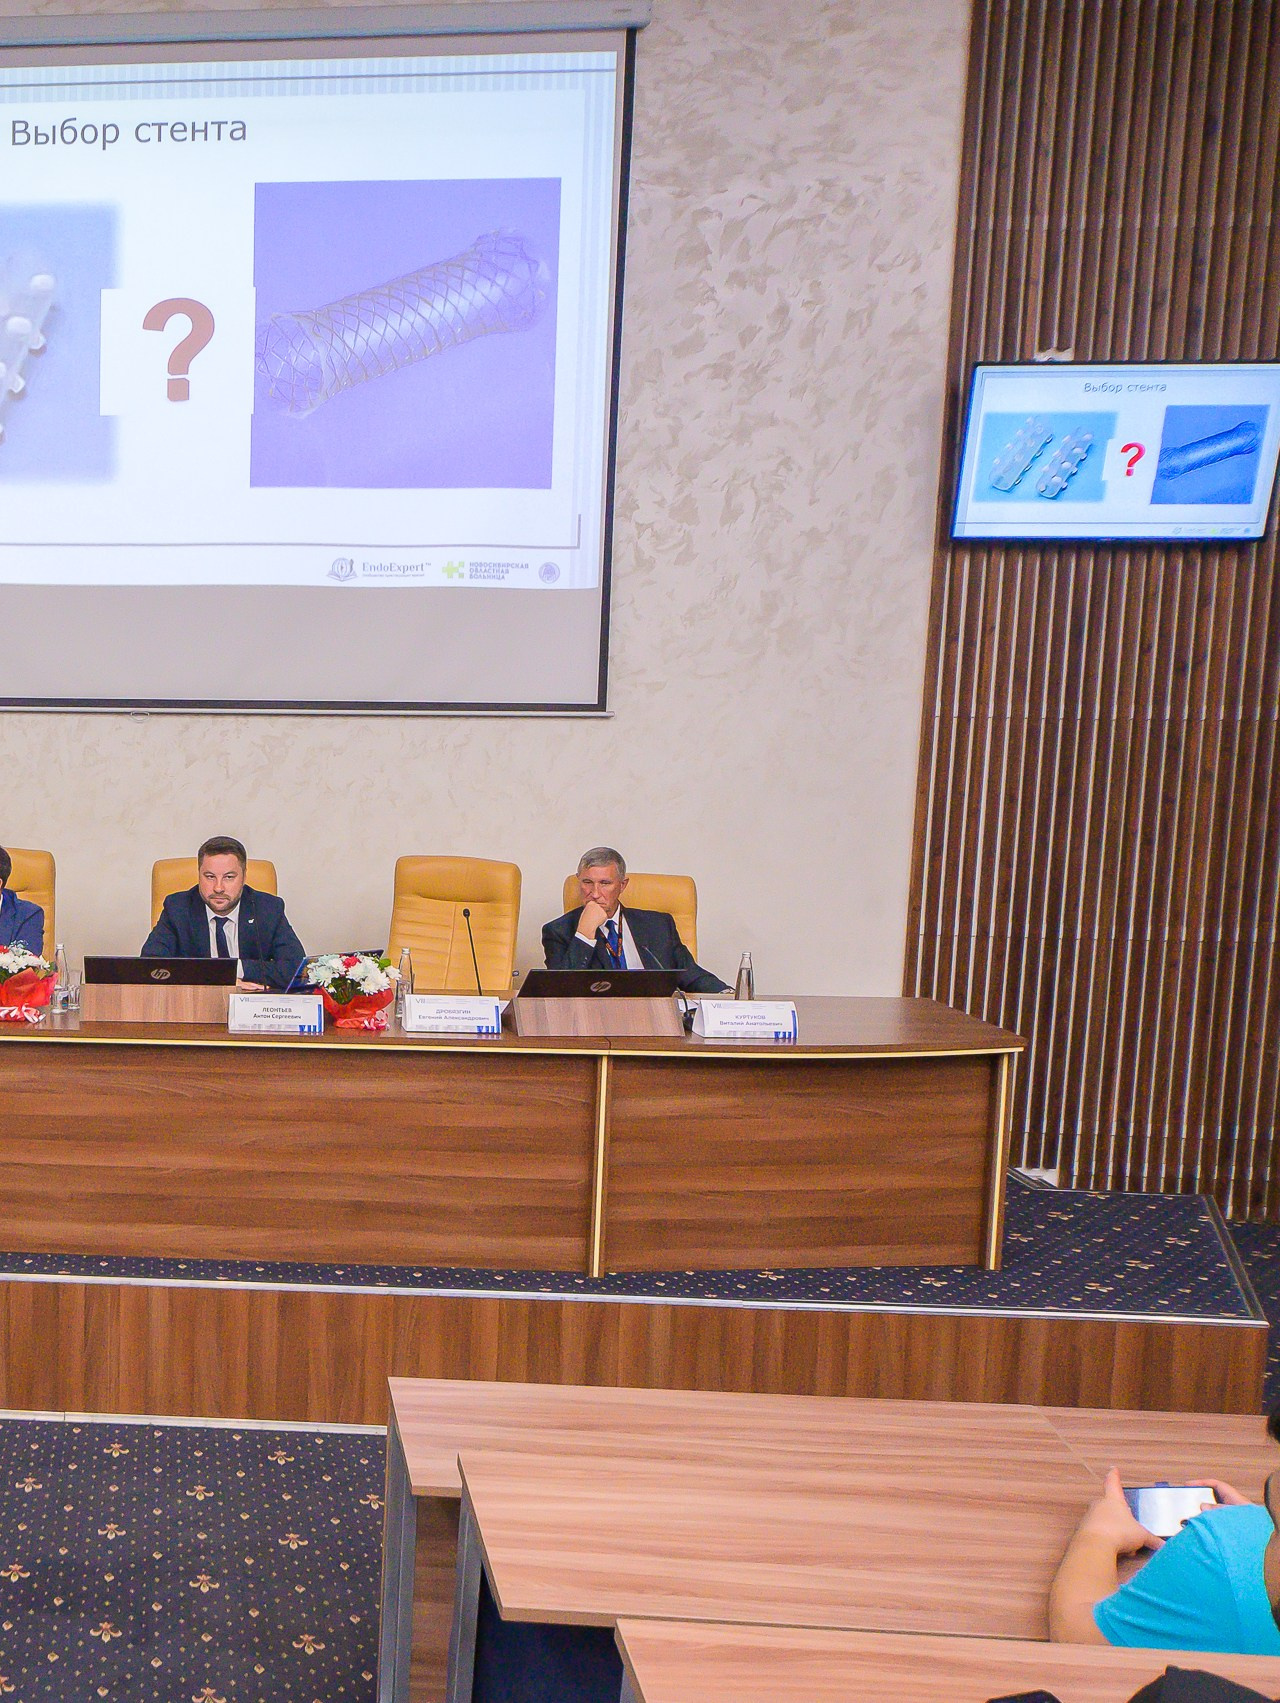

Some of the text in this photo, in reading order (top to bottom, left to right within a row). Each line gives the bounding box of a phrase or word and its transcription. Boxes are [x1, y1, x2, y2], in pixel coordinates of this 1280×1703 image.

[11, 117, 247, 151] Выбор стента
[142, 297, 216, 402] ?
[1084, 382, 1167, 393] Выбор стента
[1120, 442, 1146, 477] ?
[469, 573, 506, 581] БОЛЬНИЦА
[151, 968, 171, 980] hp
[591, 981, 612, 992] hp
